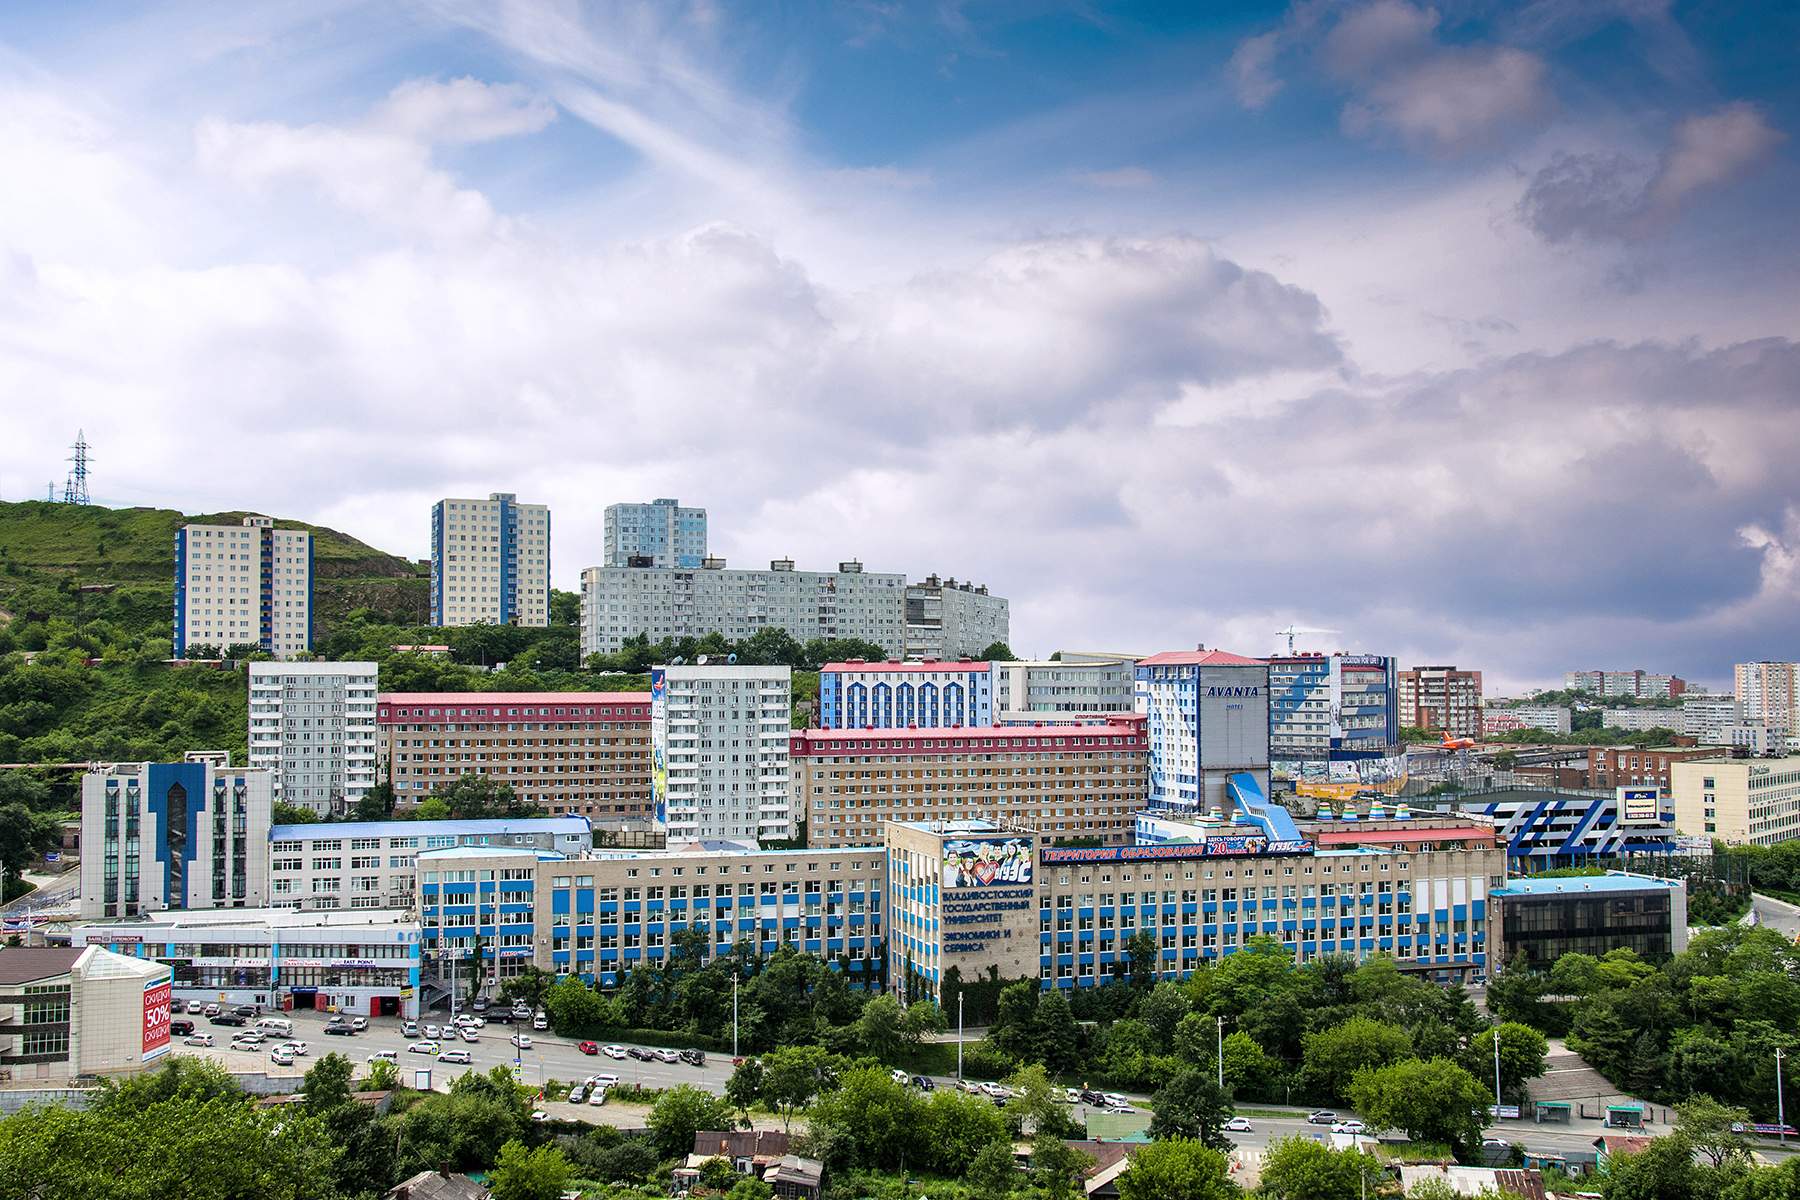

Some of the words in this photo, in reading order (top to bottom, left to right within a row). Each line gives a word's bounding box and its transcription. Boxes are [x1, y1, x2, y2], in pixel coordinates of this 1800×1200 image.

[1206, 686, 1258, 697] AVANTA
[1045, 849, 1117, 860] ТЕРРИТОРИЯ
[1121, 845, 1204, 858] ОБРАЗОВАНИЯ
[1213, 842, 1227, 854] 20
[943, 889, 1033, 901] ВЛАДИВОСТОКСКИЙ
[943, 900, 1029, 912] ГОСУДАРСТВЕННЫЙ
[944, 913, 1002, 924] УНИВЕРСИТЕТ
[944, 930, 1000, 941] ЭКОНОМИКИ
[1004, 929, 1011, 938] И
[944, 943, 984, 952] СЕРВИСА
[145, 989, 170, 1005] СКИДКИ
[145, 1024, 170, 1042] СКИДКИ
